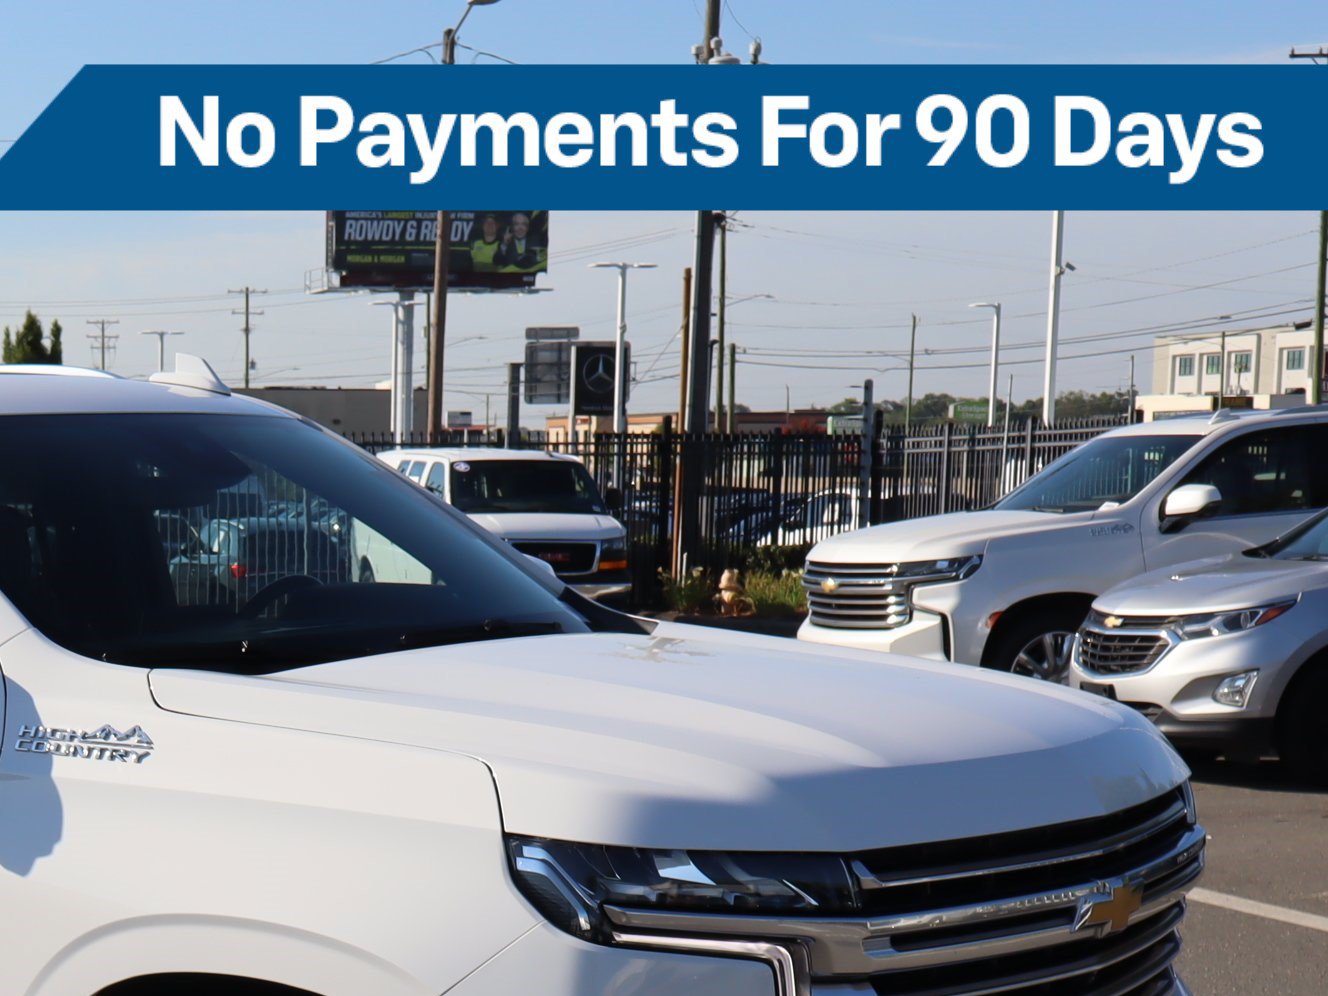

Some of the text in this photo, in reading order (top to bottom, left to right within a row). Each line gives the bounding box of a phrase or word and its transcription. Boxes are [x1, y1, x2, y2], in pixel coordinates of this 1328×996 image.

[344, 219, 474, 241] ROWDY & REDY
[346, 254, 373, 263] MORGAN
[379, 254, 406, 263] MORGAN
[18, 725, 88, 742] HIGH
[14, 739, 151, 763] COUNTRY
